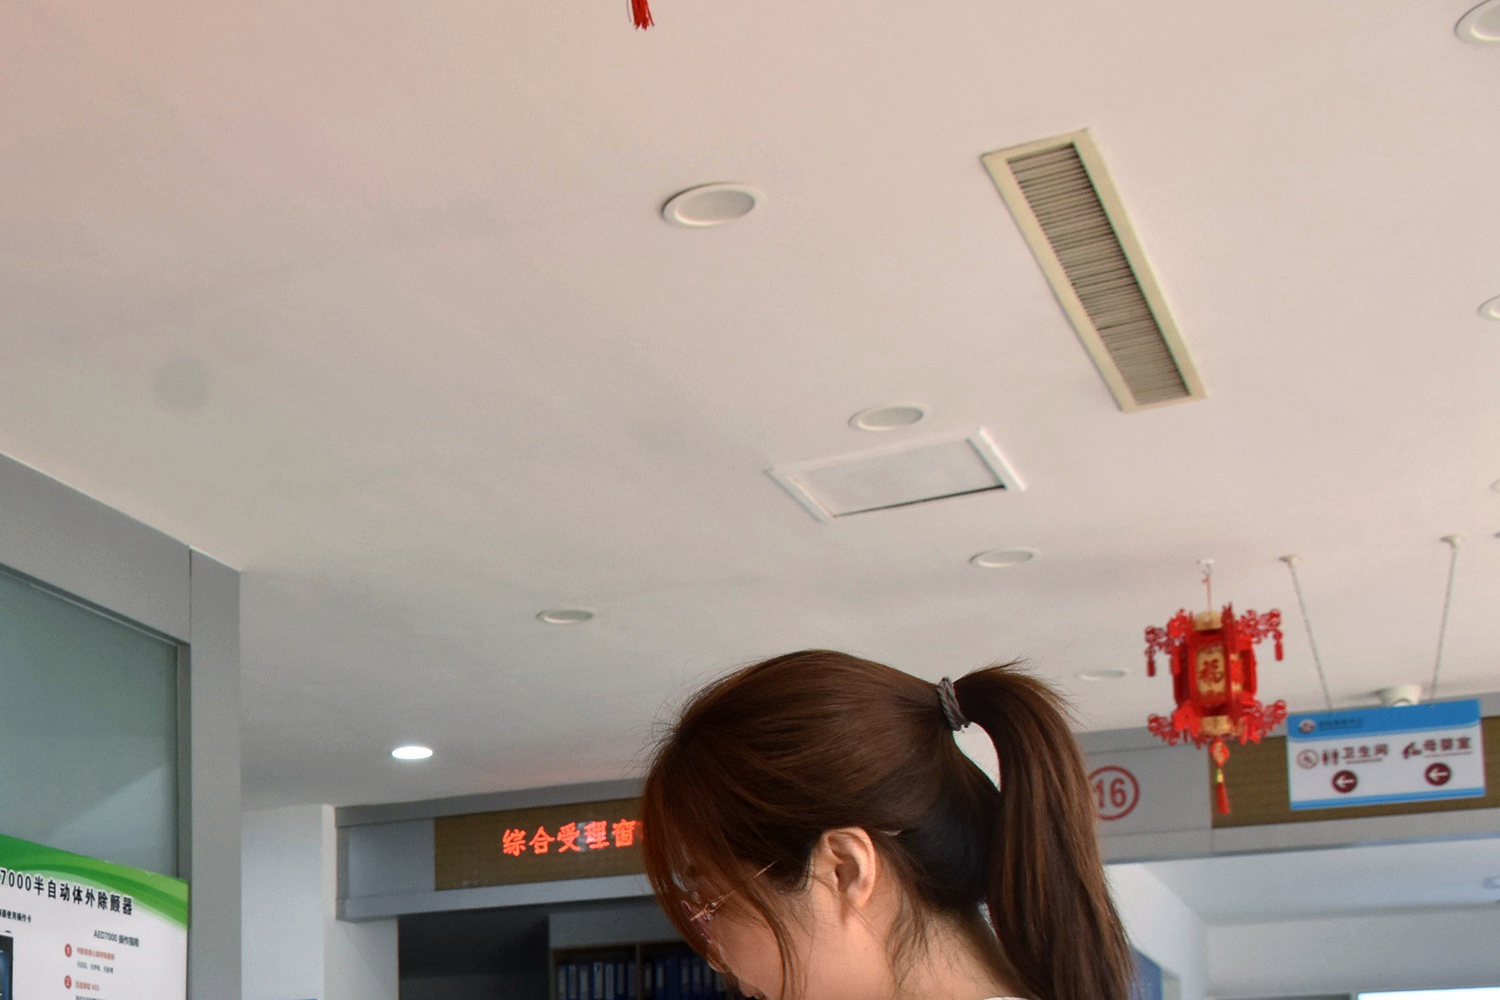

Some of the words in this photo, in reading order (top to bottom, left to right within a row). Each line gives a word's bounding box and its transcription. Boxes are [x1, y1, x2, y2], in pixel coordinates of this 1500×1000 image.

[1343, 743, 1388, 760] 卫生间
[1423, 737, 1471, 752] 母婴室
[1094, 778, 1126, 808] 16
[502, 819, 644, 857] 综合受理窗
